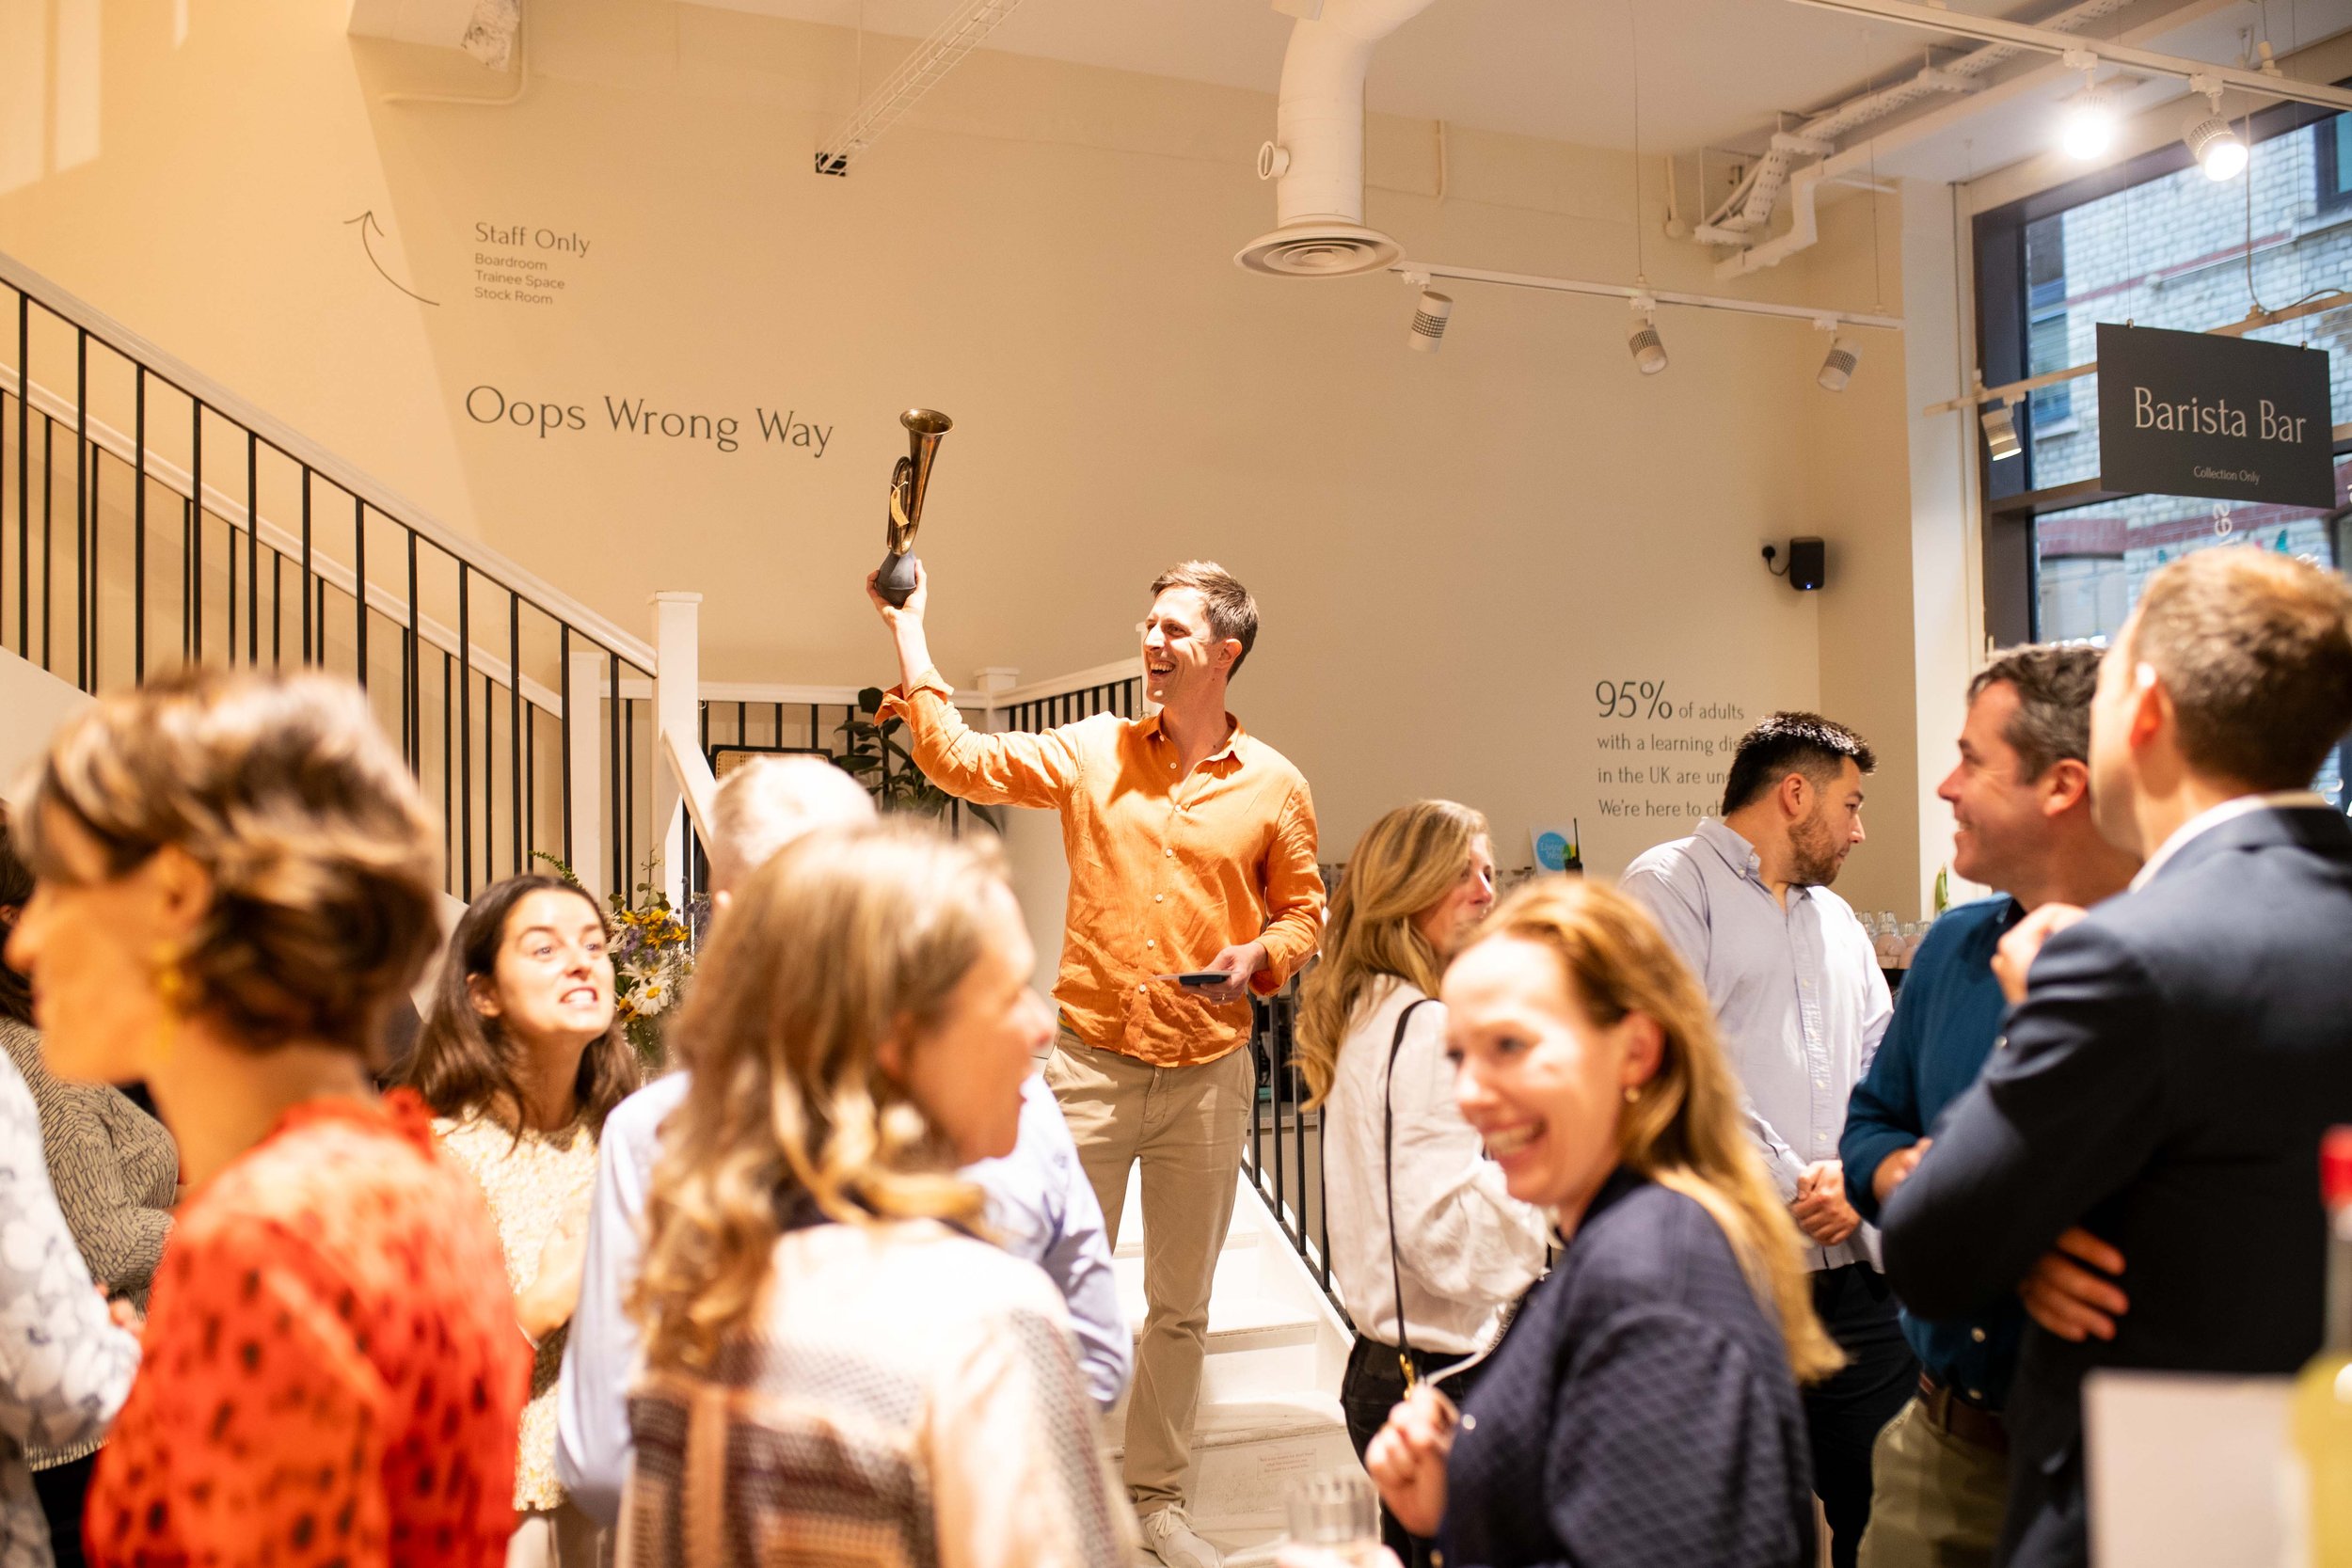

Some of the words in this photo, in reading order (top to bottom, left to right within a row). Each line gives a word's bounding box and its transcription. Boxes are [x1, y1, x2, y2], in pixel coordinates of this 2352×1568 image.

[475, 222, 526, 245] Staff
[534, 229, 591, 259] Only
[474, 253, 548, 271] Boardroom
[474, 270, 522, 286] Trainee
[525, 275, 565, 290] Space
[474, 286, 511, 301] Stock
[515, 290, 553, 305] Room
[466, 385, 586, 438] Oops
[604, 395, 739, 452] Wrong
[755, 407, 834, 459] Way
[2133, 386, 2247, 437] Barista
[2259, 399, 2307, 444] Bar
[2193, 465, 2238, 481] Collection
[2239, 469, 2261, 486] Only
[1595, 680, 1673, 720] 95%
[1678, 702, 1693, 719] of
[1698, 702, 1745, 720] adults
[1597, 733, 1631, 751] with
[1636, 738, 1645, 751] a
[1650, 734, 1714, 756] learning
[1597, 767, 1613, 784] in
[1618, 767, 1644, 784] the
[1649, 767, 1671, 784] UK
[1677, 771, 1701, 784] are
[1597, 799, 1640, 817] We're
[1645, 800, 1681, 817] here
[1686, 800, 1702, 817] to
